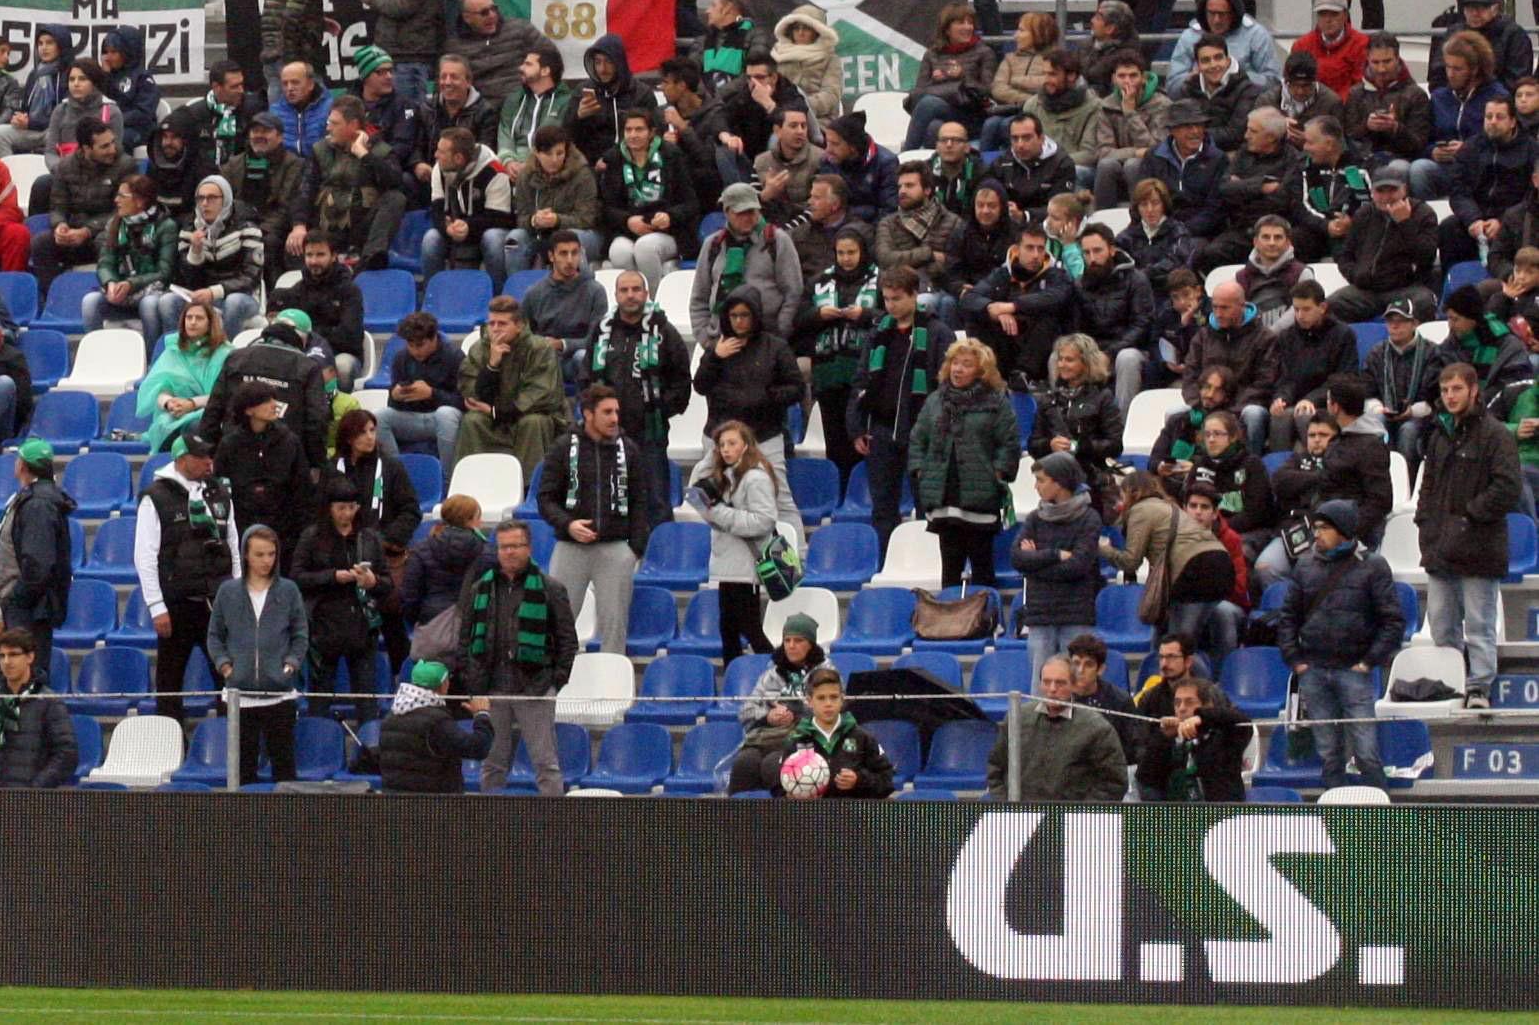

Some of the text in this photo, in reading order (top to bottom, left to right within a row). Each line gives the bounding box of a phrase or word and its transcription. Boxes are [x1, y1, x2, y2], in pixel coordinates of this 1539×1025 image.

[543, 0, 597, 40] 88
[1499, 681, 1511, 703] F
[1464, 749, 1522, 774] F 03
[946, 811, 1406, 985] U.S.
